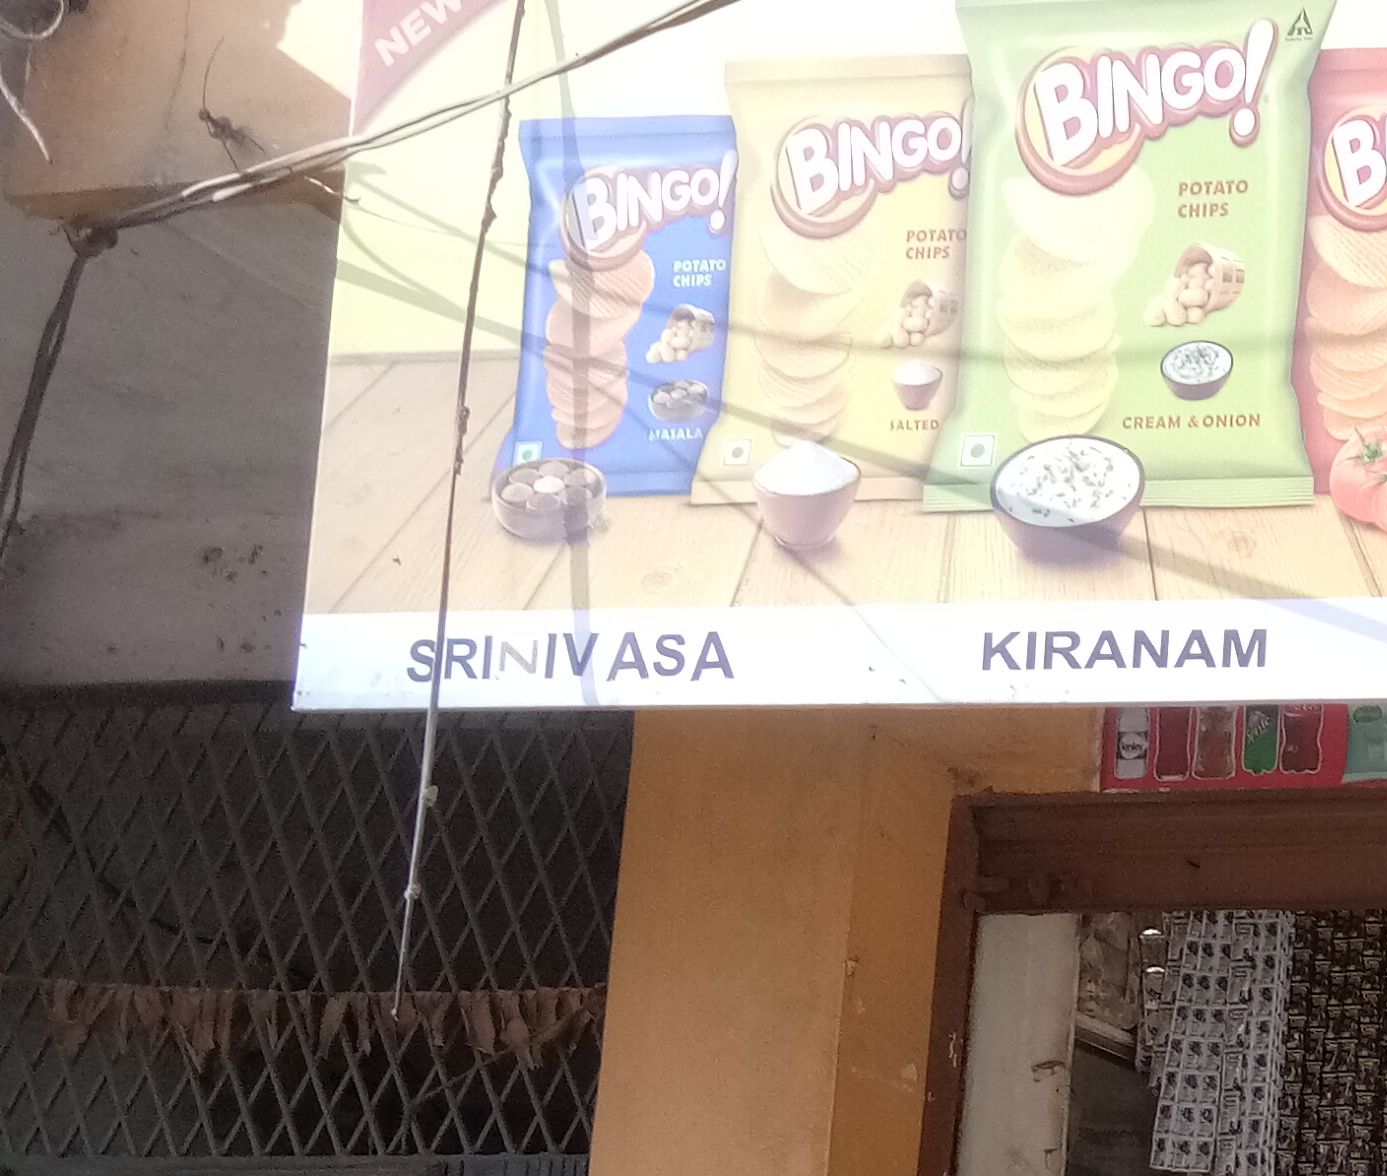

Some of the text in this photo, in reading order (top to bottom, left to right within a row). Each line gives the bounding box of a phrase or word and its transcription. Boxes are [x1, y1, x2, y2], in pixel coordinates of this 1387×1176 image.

[1034, 19, 1277, 166] BINGO!
[787, 99, 972, 212] BINGO!
[1177, 179, 1249, 197] POTATO
[582, 149, 738, 251] BINGO!
[1177, 202, 1230, 218] CHIPS
[905, 229, 967, 243] POTATO
[905, 246, 950, 260] CHIPS
[673, 259, 727, 273] POTATO
[673, 274, 712, 287] CHIPS
[889, 419, 941, 432] SALTED
[1121, 412, 1261, 430] CREAM & ONION
[982, 628, 1268, 671] KIRANAM
